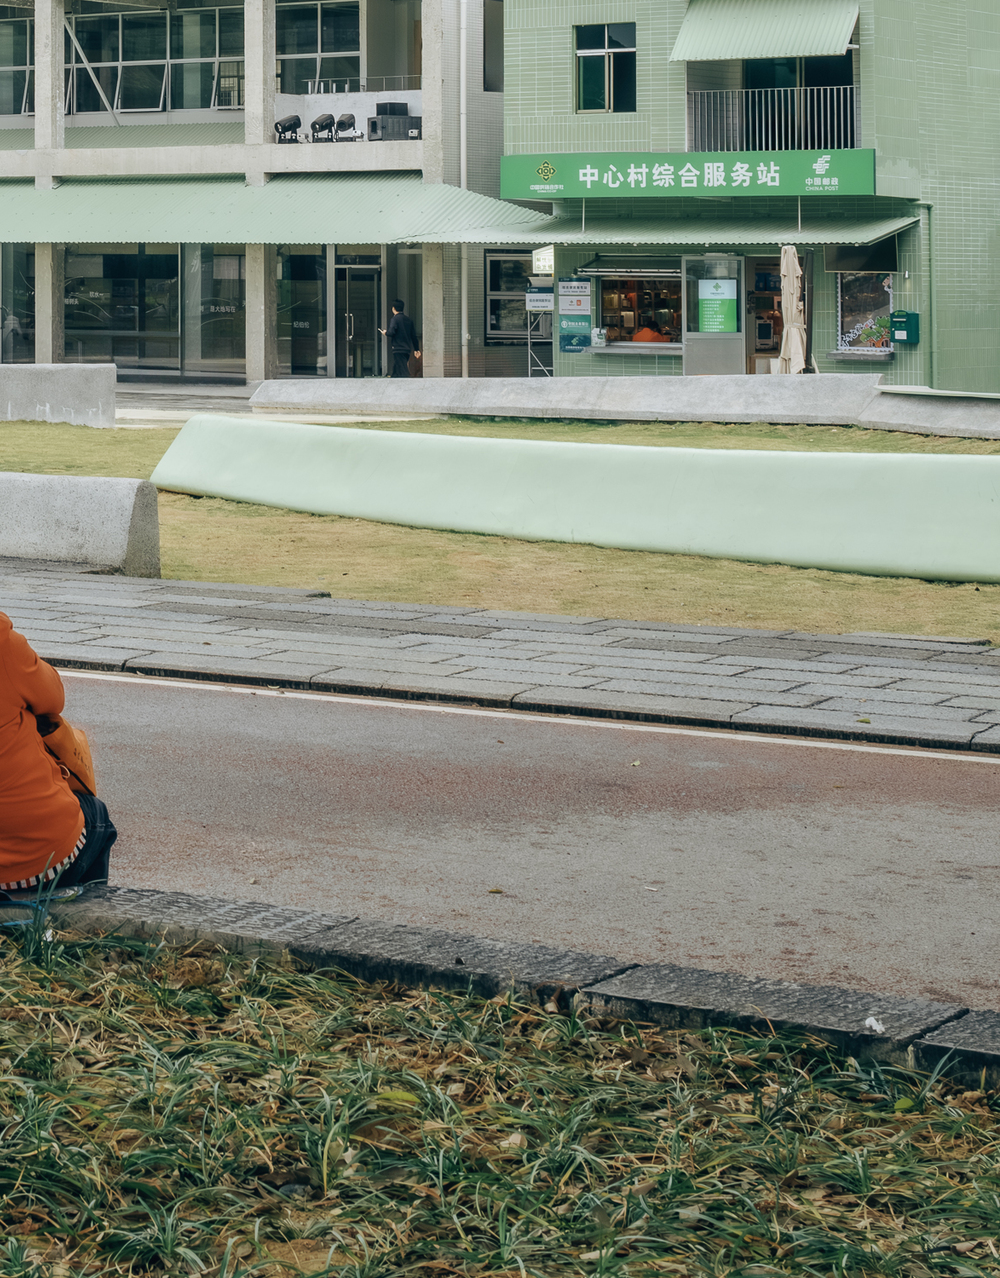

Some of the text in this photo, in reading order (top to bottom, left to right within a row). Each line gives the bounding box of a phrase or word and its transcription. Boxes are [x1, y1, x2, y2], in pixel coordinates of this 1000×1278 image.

[578, 161, 780, 189] 中心村综合服务站
[805, 177, 839, 186] 中国邮政
